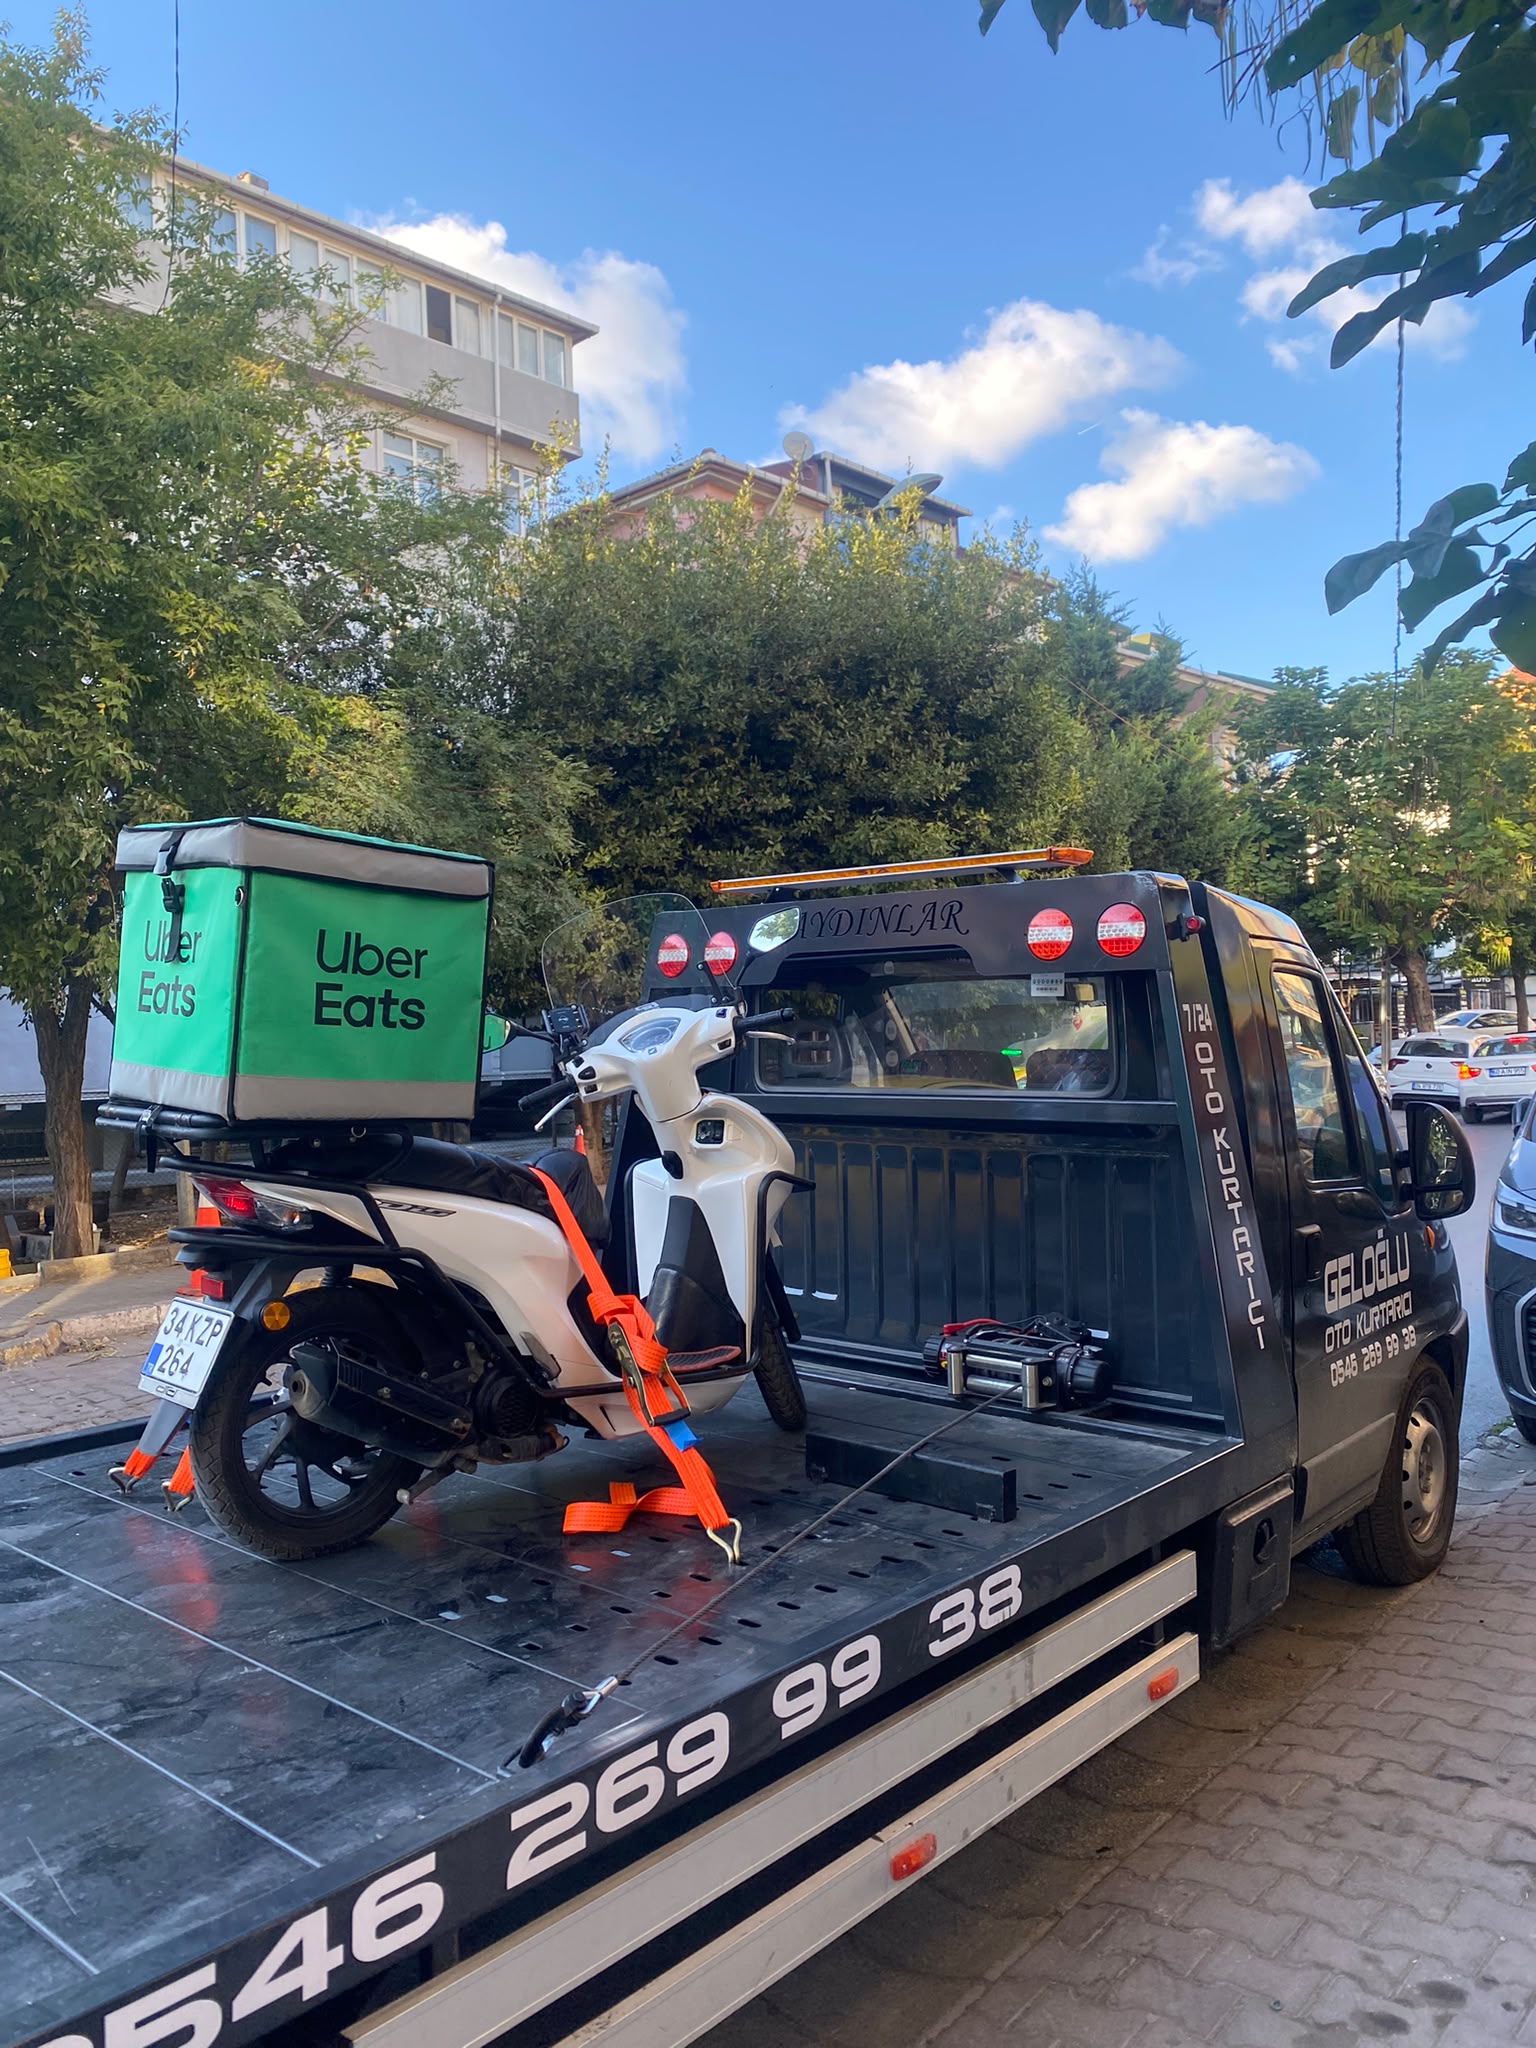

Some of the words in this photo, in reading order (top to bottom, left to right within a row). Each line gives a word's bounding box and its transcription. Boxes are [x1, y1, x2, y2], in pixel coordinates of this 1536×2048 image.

[144, 919, 202, 963] Uber
[315, 928, 428, 979] Uber
[138, 970, 195, 1017] Eats
[313, 981, 426, 1031] Eats
[1182, 1003, 1213, 1033] 7/24
[1195, 1042, 1224, 1114] OTO
[1212, 1127, 1266, 1351] KURTARICI
[163, 1307, 189, 1338] 34
[184, 1312, 224, 1348] KZP
[1325, 1318, 1351, 1354] OTO
[157, 1343, 194, 1377] 264
[1330, 1352, 1359, 1388] 0546
[1361, 1341, 1383, 1372] 269
[1385, 1333, 1400, 1359] 99
[1402, 1324, 1417, 1351] 38
[37, 1851, 444, 2048] 546
[507, 1712, 729, 1890] 269
[772, 1634, 881, 1739] 99
[928, 1564, 1022, 1657] 38
